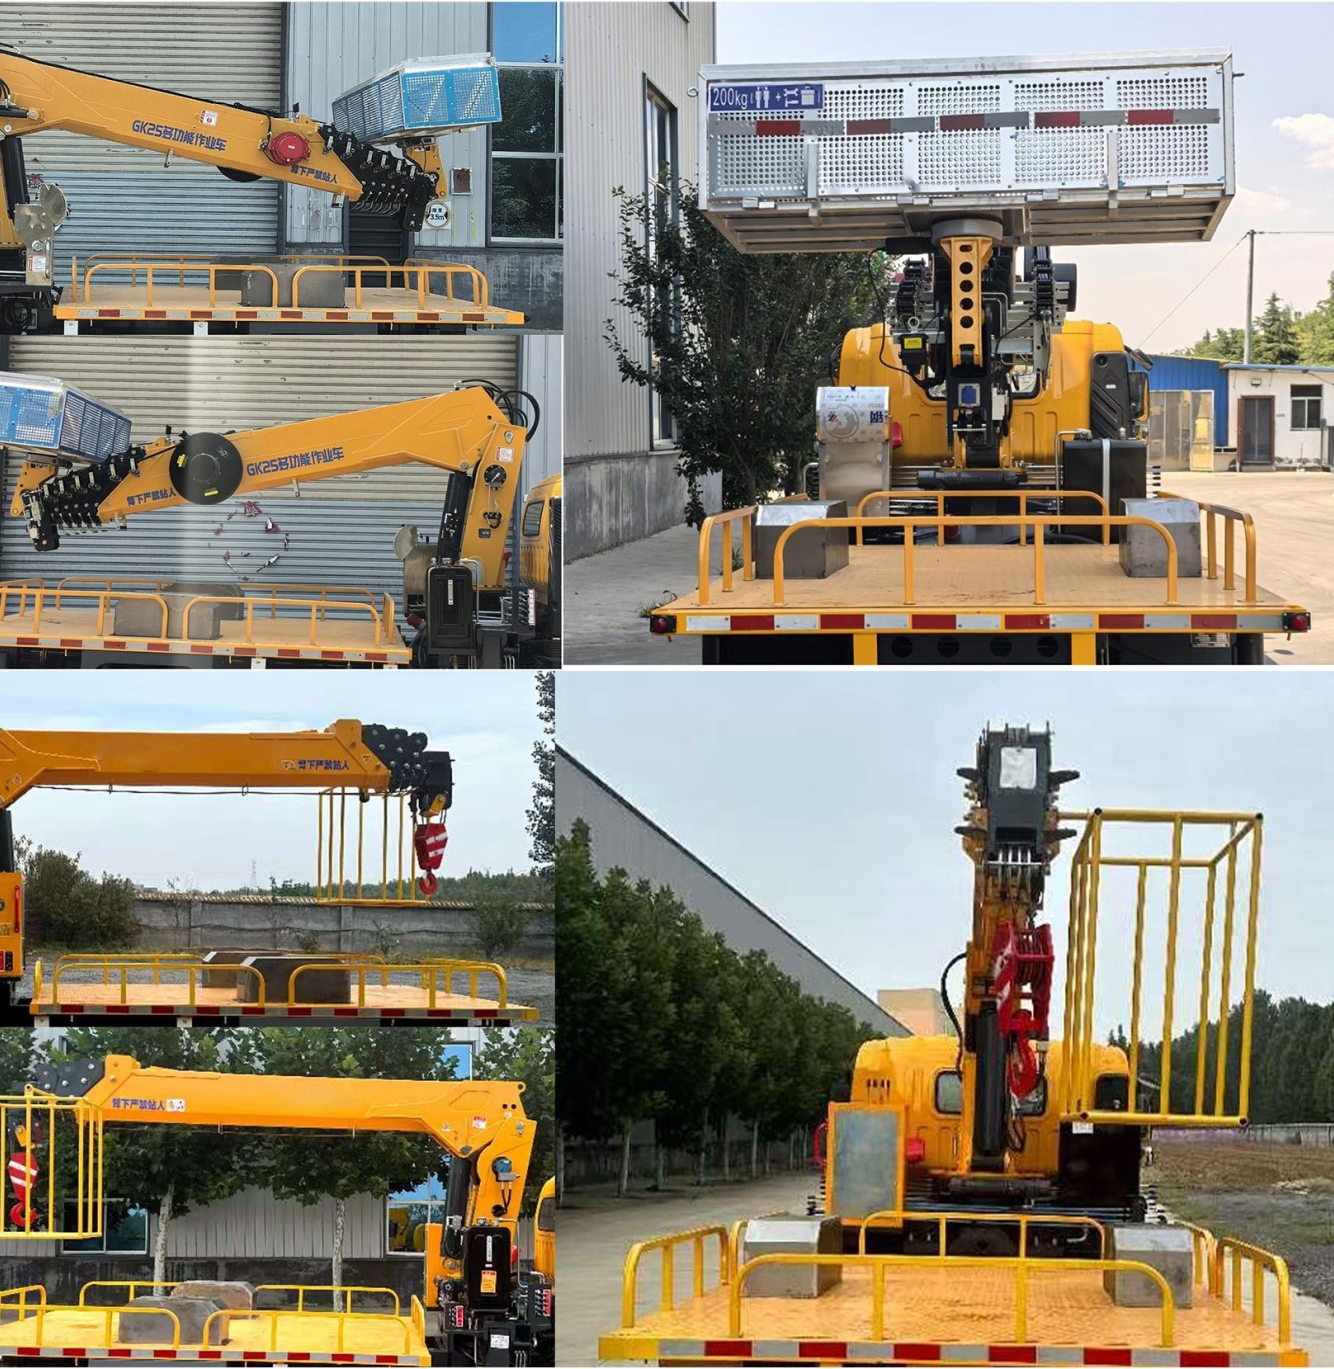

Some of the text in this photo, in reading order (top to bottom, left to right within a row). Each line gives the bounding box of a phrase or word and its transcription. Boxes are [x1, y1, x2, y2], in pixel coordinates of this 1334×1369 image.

[712, 87, 748, 109] 200kg
[132, 119, 227, 152] GK25多功能作业车
[247, 446, 344, 476] GK25多功能作业车
